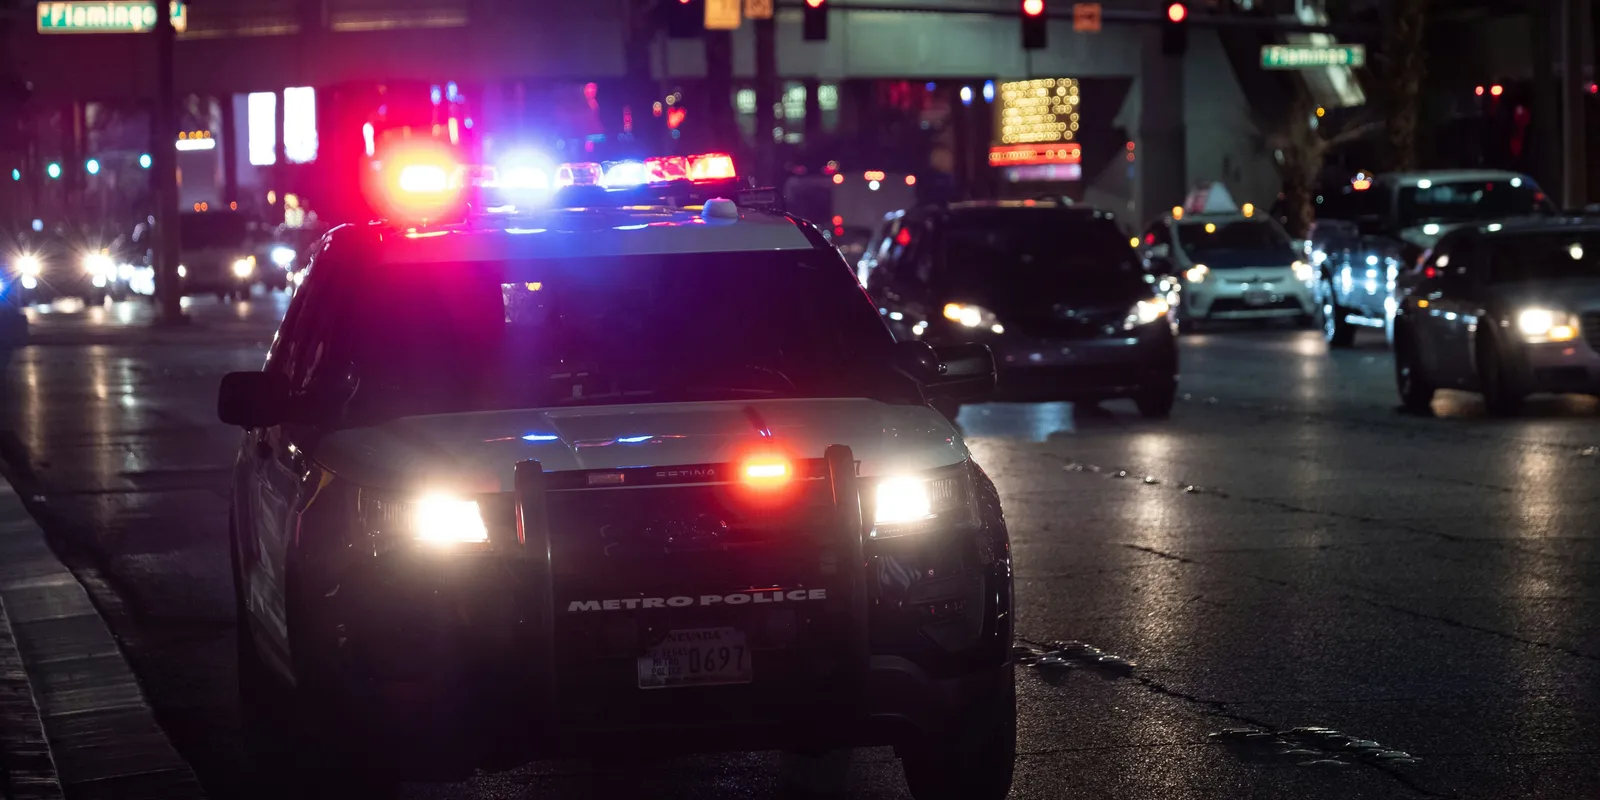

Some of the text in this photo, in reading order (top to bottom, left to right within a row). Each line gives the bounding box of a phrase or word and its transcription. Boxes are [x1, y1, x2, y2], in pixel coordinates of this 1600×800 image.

[51, 3, 156, 31] Flamingo
[568, 589, 827, 612] METRO POLICE
[667, 631, 721, 643] NEVADA
[689, 645, 745, 674] 0697
